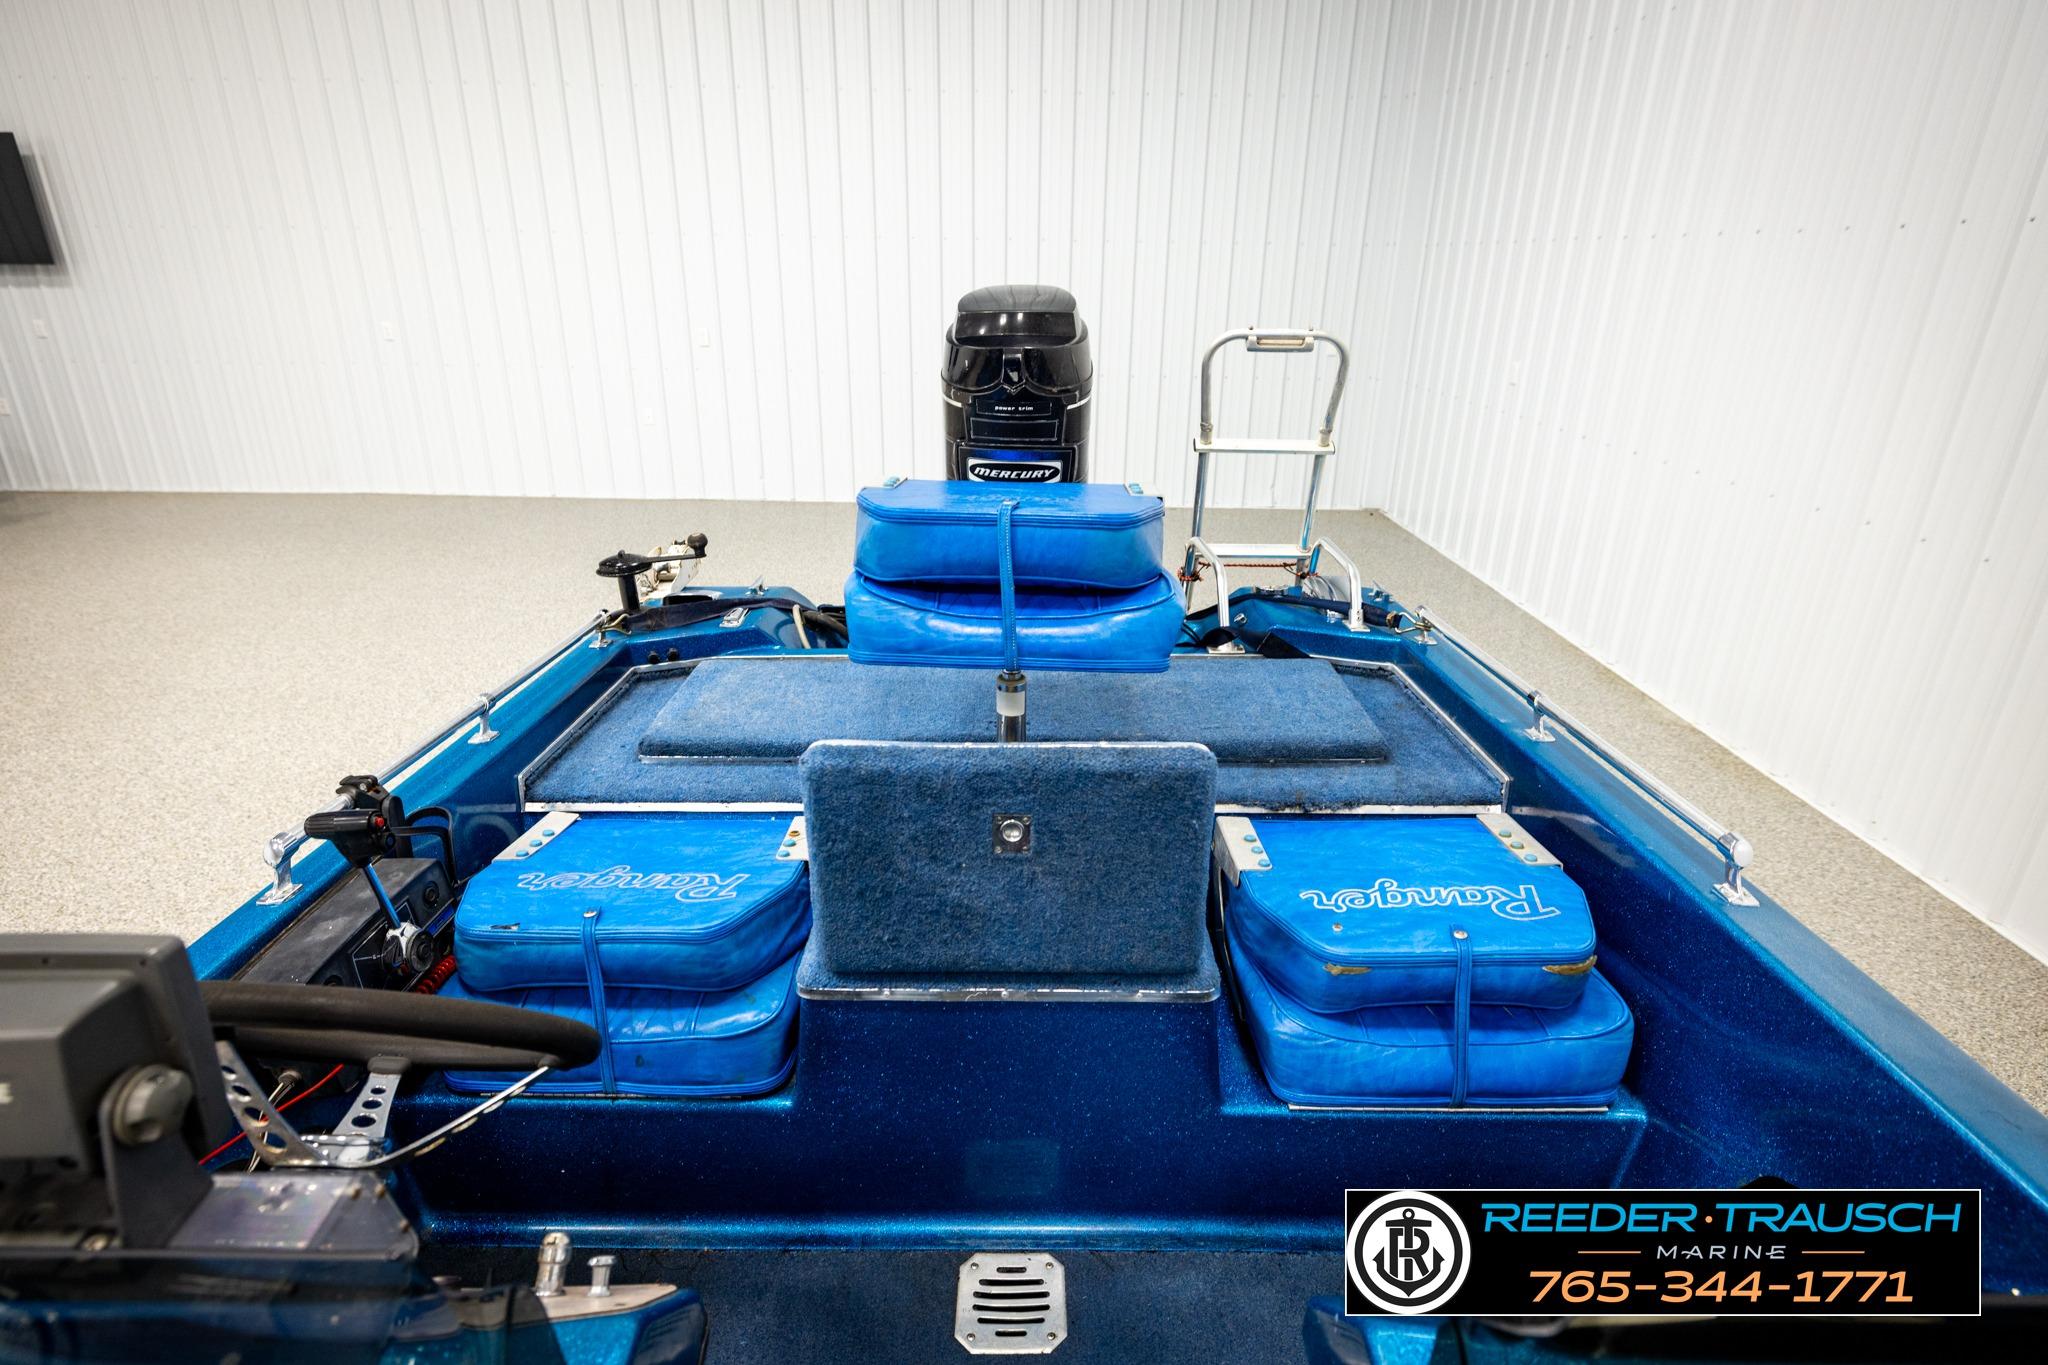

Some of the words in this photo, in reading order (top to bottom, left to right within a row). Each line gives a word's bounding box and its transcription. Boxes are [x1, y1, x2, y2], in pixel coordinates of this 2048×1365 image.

[973, 466, 1055, 479] MERCURY
[517, 864, 751, 902] Ranger
[1299, 877, 1562, 921] Ranger
